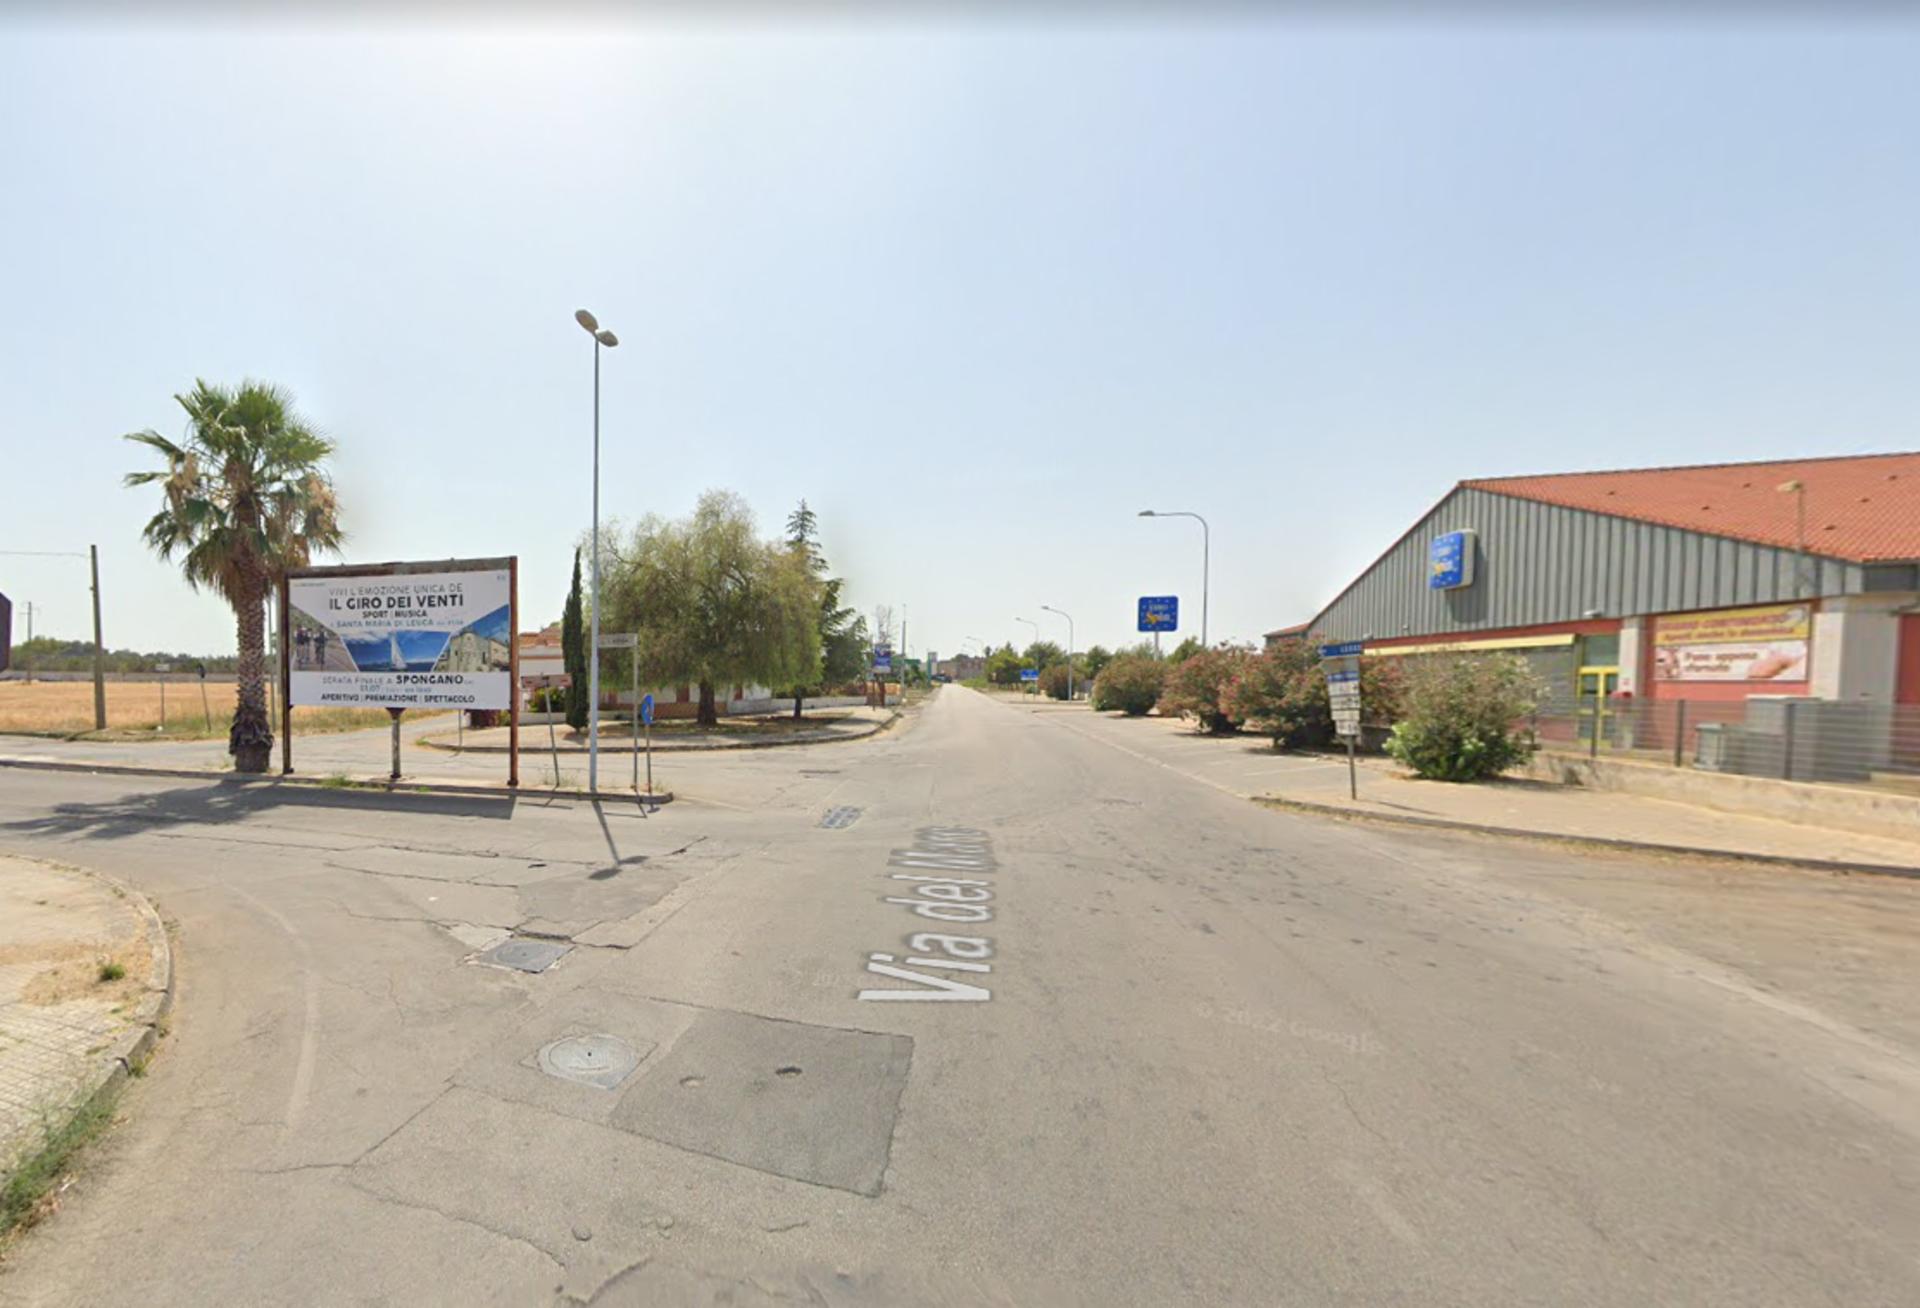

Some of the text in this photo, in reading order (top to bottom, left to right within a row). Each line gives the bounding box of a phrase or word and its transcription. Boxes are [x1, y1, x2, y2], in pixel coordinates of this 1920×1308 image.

[413, 583, 446, 594] UNICA
[449, 582, 464, 593] DE
[329, 593, 464, 610] IL GIRO DEI VENTI
[362, 609, 428, 619] SPORT MUSICA
[336, 620, 363, 628] SANTA
[365, 620, 392, 628] MARIA
[395, 674, 464, 685] SPONGANO
[321, 693, 475, 703] APERITIVO PREMIAZIONE SPETTACOLO
